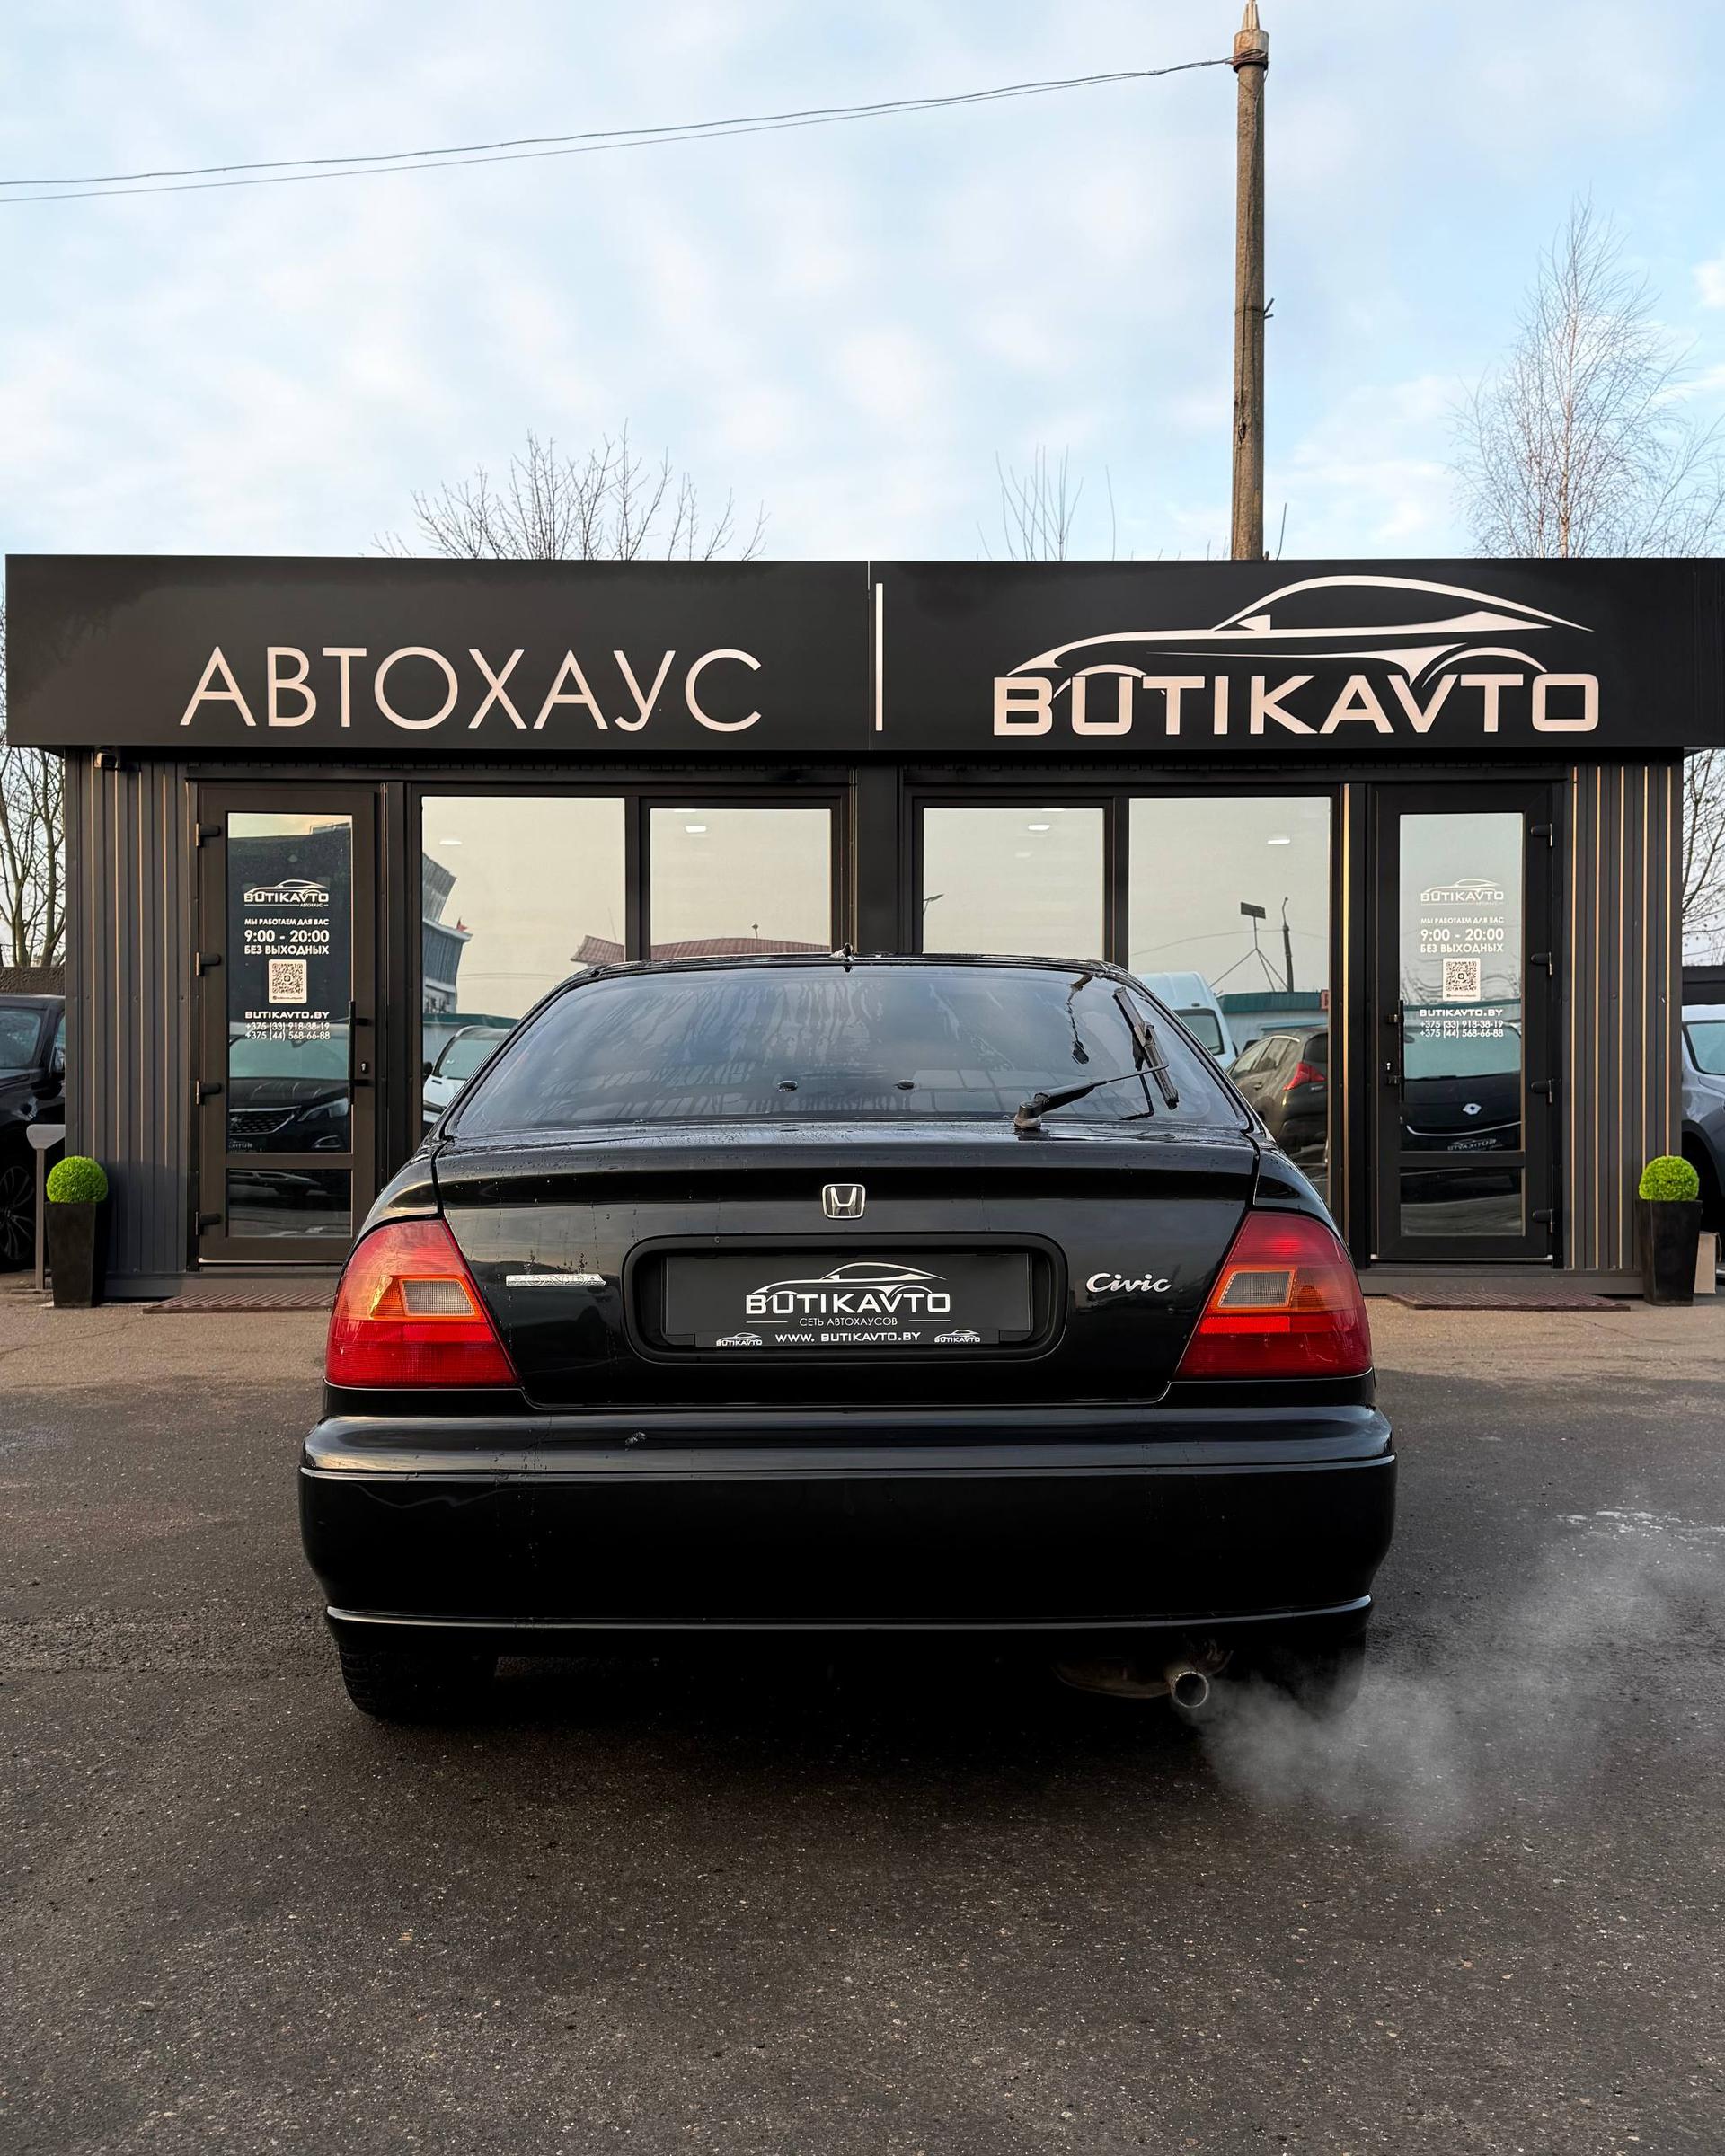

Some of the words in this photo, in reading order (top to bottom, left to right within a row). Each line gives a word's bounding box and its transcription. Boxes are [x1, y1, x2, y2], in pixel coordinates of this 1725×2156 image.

[180, 646, 762, 732] АВТОХАУС
[993, 673, 1599, 736] BUTIKAVTO
[243, 892, 329, 903] BUTIKAVTO
[1420, 891, 1504, 902] BUTIKAVTO
[296, 918, 313, 926] ДЛЯ
[244, 930, 276, 943] 9:00
[289, 929, 330, 943] 20:00
[1420, 929, 1450, 941] 9:00
[1464, 928, 1504, 941] 20:00
[244, 945, 262, 955] БЕЗ
[264, 945, 330, 956] ВЫХОДНЫХ
[1420, 944, 1438, 953] БЕЗ
[1440, 943, 1504, 954] ВЫХОДНЫХ
[244, 1011, 330, 1019] BUTIKAVTO.BY
[1420, 1009, 1504, 1017] BUTIKAVTO.BY
[245, 1022, 267, 1030] +375
[270, 1022, 286, 1032] (33)
[288, 1022, 330, 1030] 918-38-19
[1420, 1021, 1441, 1029] +375
[1443, 1021, 1459, 1029] (33)
[1462, 1021, 1504, 1029] 918-38-19
[245, 1031, 267, 1039] +375
[270, 1030, 286, 1041] (44)
[288, 1031, 330, 1040] 568-66-88
[1420, 1029, 1441, 1038] +375
[1443, 1029, 1459, 1039] (44)
[1462, 1029, 1504, 1038] 568-66-88
[1086, 1272, 1172, 1293] Civic
[746, 1293, 951, 1314] BUTIKAVTO
[799, 1317, 825, 1327] СЕТЬ
[827, 1316, 898, 1327] АВТОХАУСОВ
[775, 1334, 815, 1343] WWW.
[821, 1331, 921, 1342] BUTIKAVTO.BY
[933, 1335, 981, 1343] BUTIKAVTO
[716, 1339, 763, 1347] BUTIKAVTO
